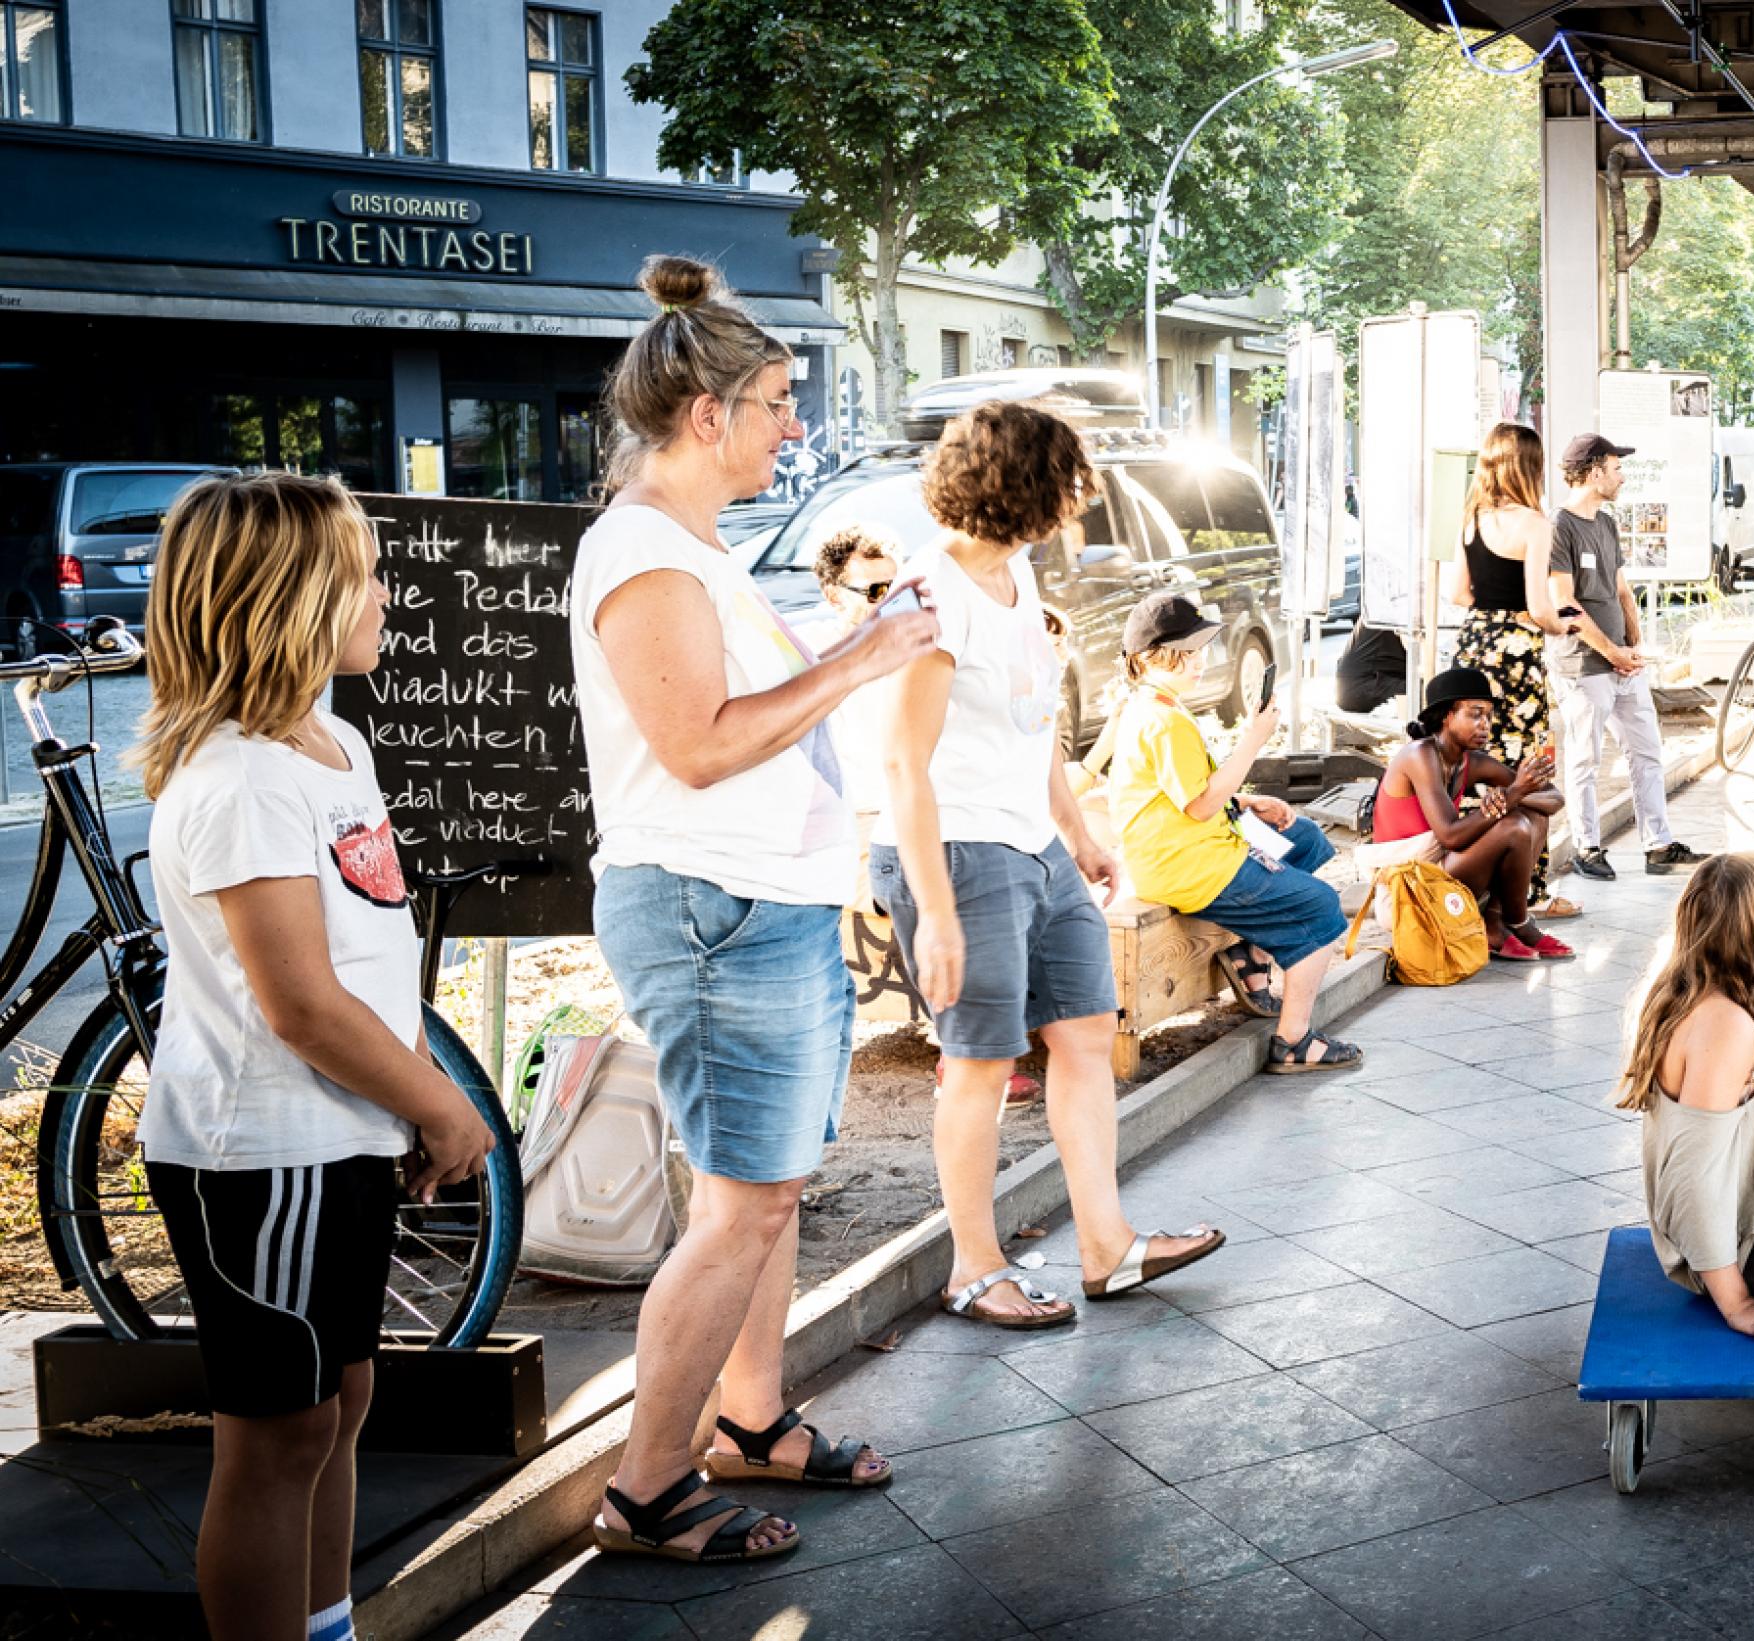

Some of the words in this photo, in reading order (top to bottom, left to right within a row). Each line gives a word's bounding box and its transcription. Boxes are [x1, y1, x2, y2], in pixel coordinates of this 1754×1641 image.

[350, 193, 470, 220] RISTORANTE
[281, 217, 533, 274] TRENTASEI
[461, 620, 538, 659] das
[366, 667, 532, 706] Viadukt
[367, 713, 547, 753] leuchten
[381, 778, 444, 811] edal
[465, 778, 542, 812] here
